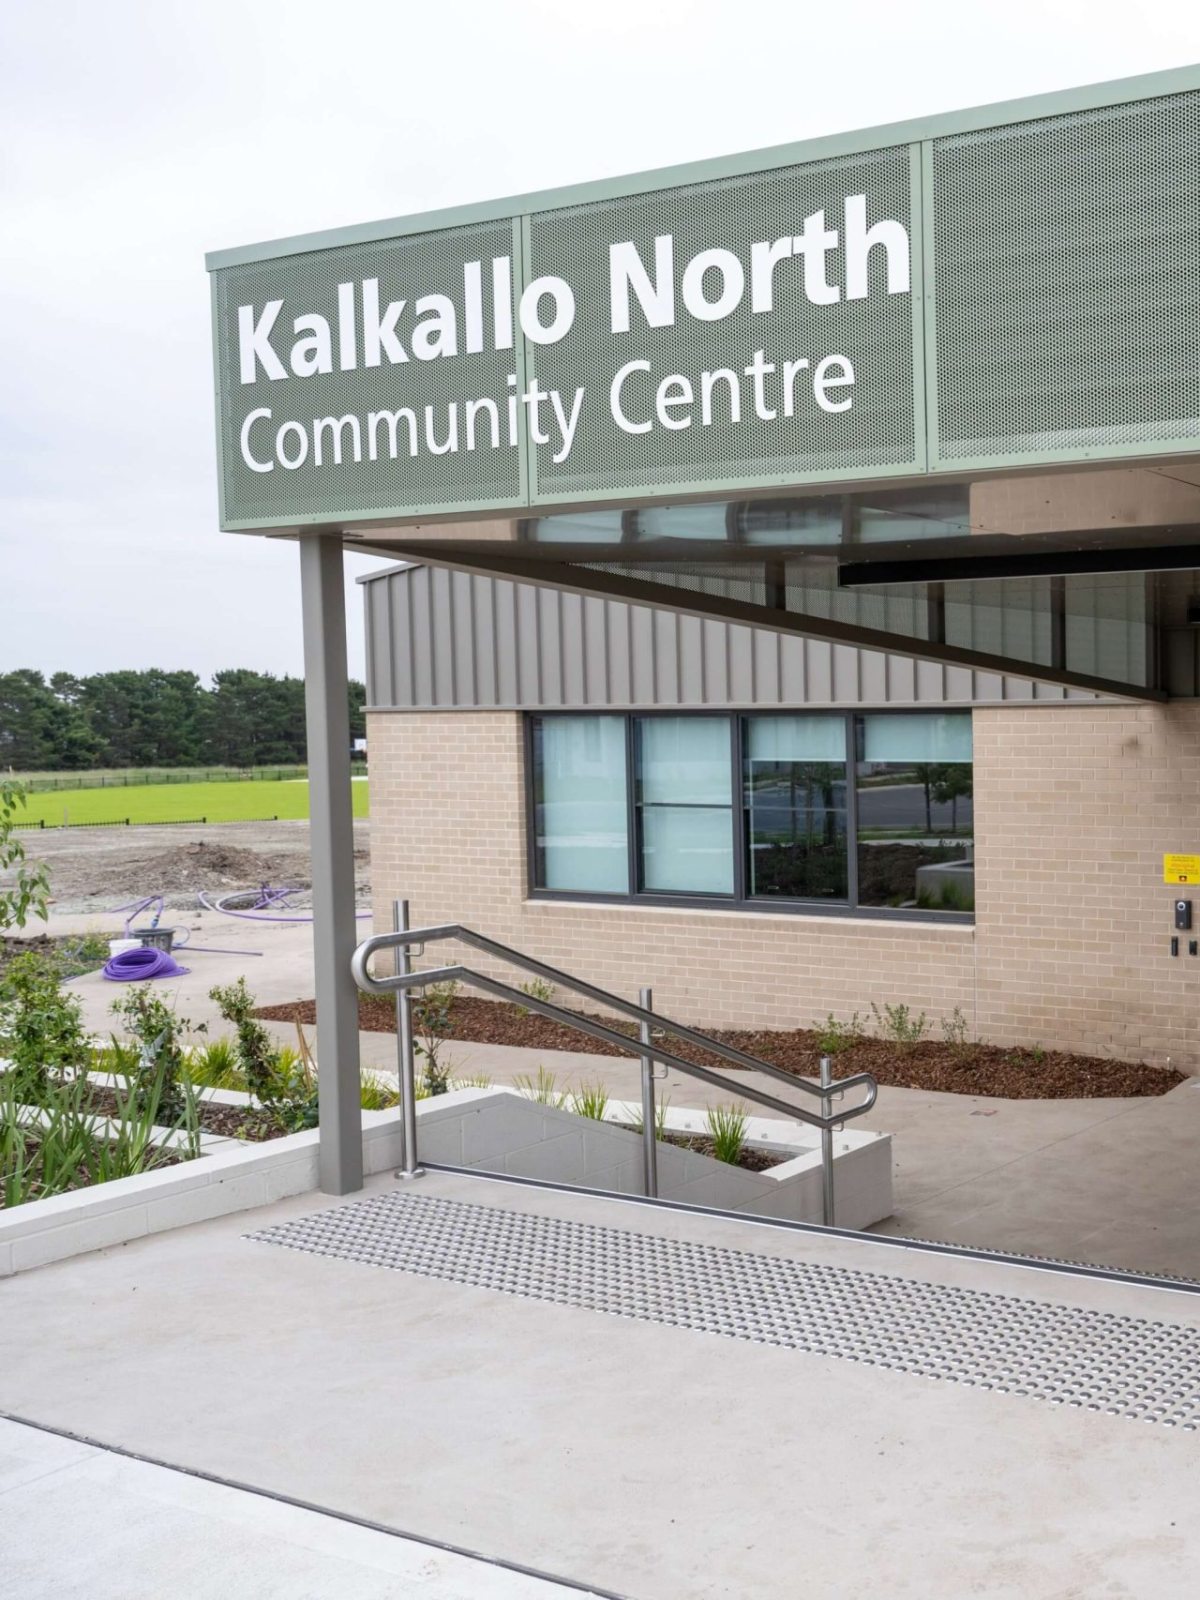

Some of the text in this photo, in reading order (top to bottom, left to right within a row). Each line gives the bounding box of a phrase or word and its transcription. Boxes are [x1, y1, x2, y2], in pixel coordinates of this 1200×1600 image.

[237, 193, 911, 384] Kalkallo North
[239, 349, 855, 472] Community Centre
